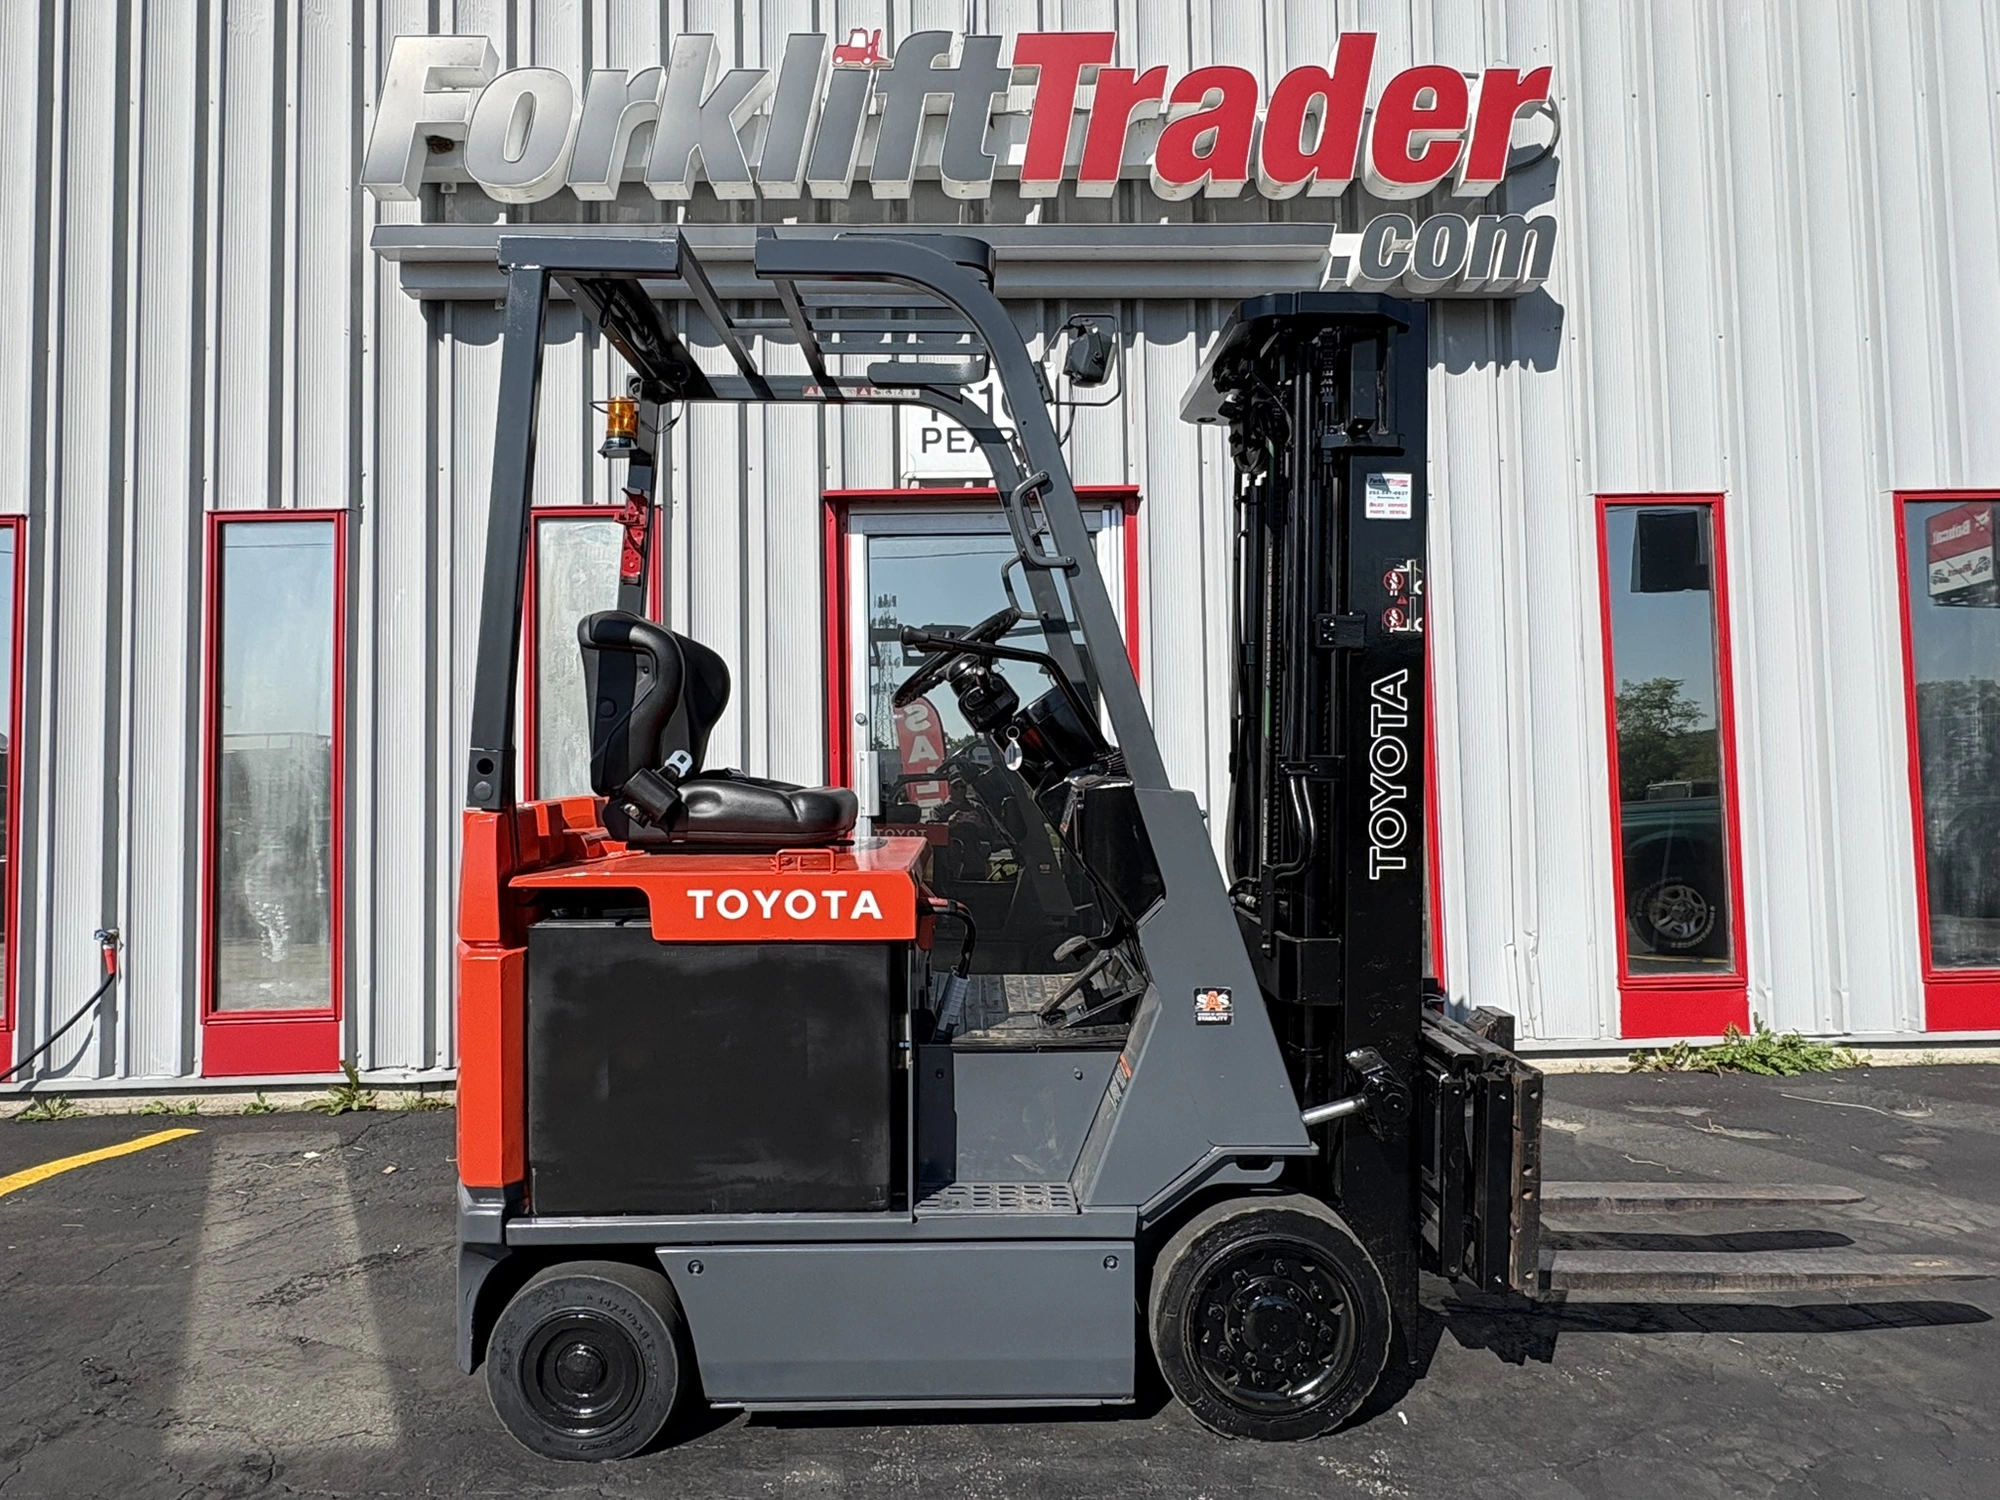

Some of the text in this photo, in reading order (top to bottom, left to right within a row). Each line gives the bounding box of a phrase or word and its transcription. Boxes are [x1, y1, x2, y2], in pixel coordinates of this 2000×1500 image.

[360, 30, 1555, 202] ForkliftTrader
[1323, 212, 1558, 293] .com
[1368, 668, 1408, 880] TOYOTA
[687, 889, 883, 920] TOYOTA
